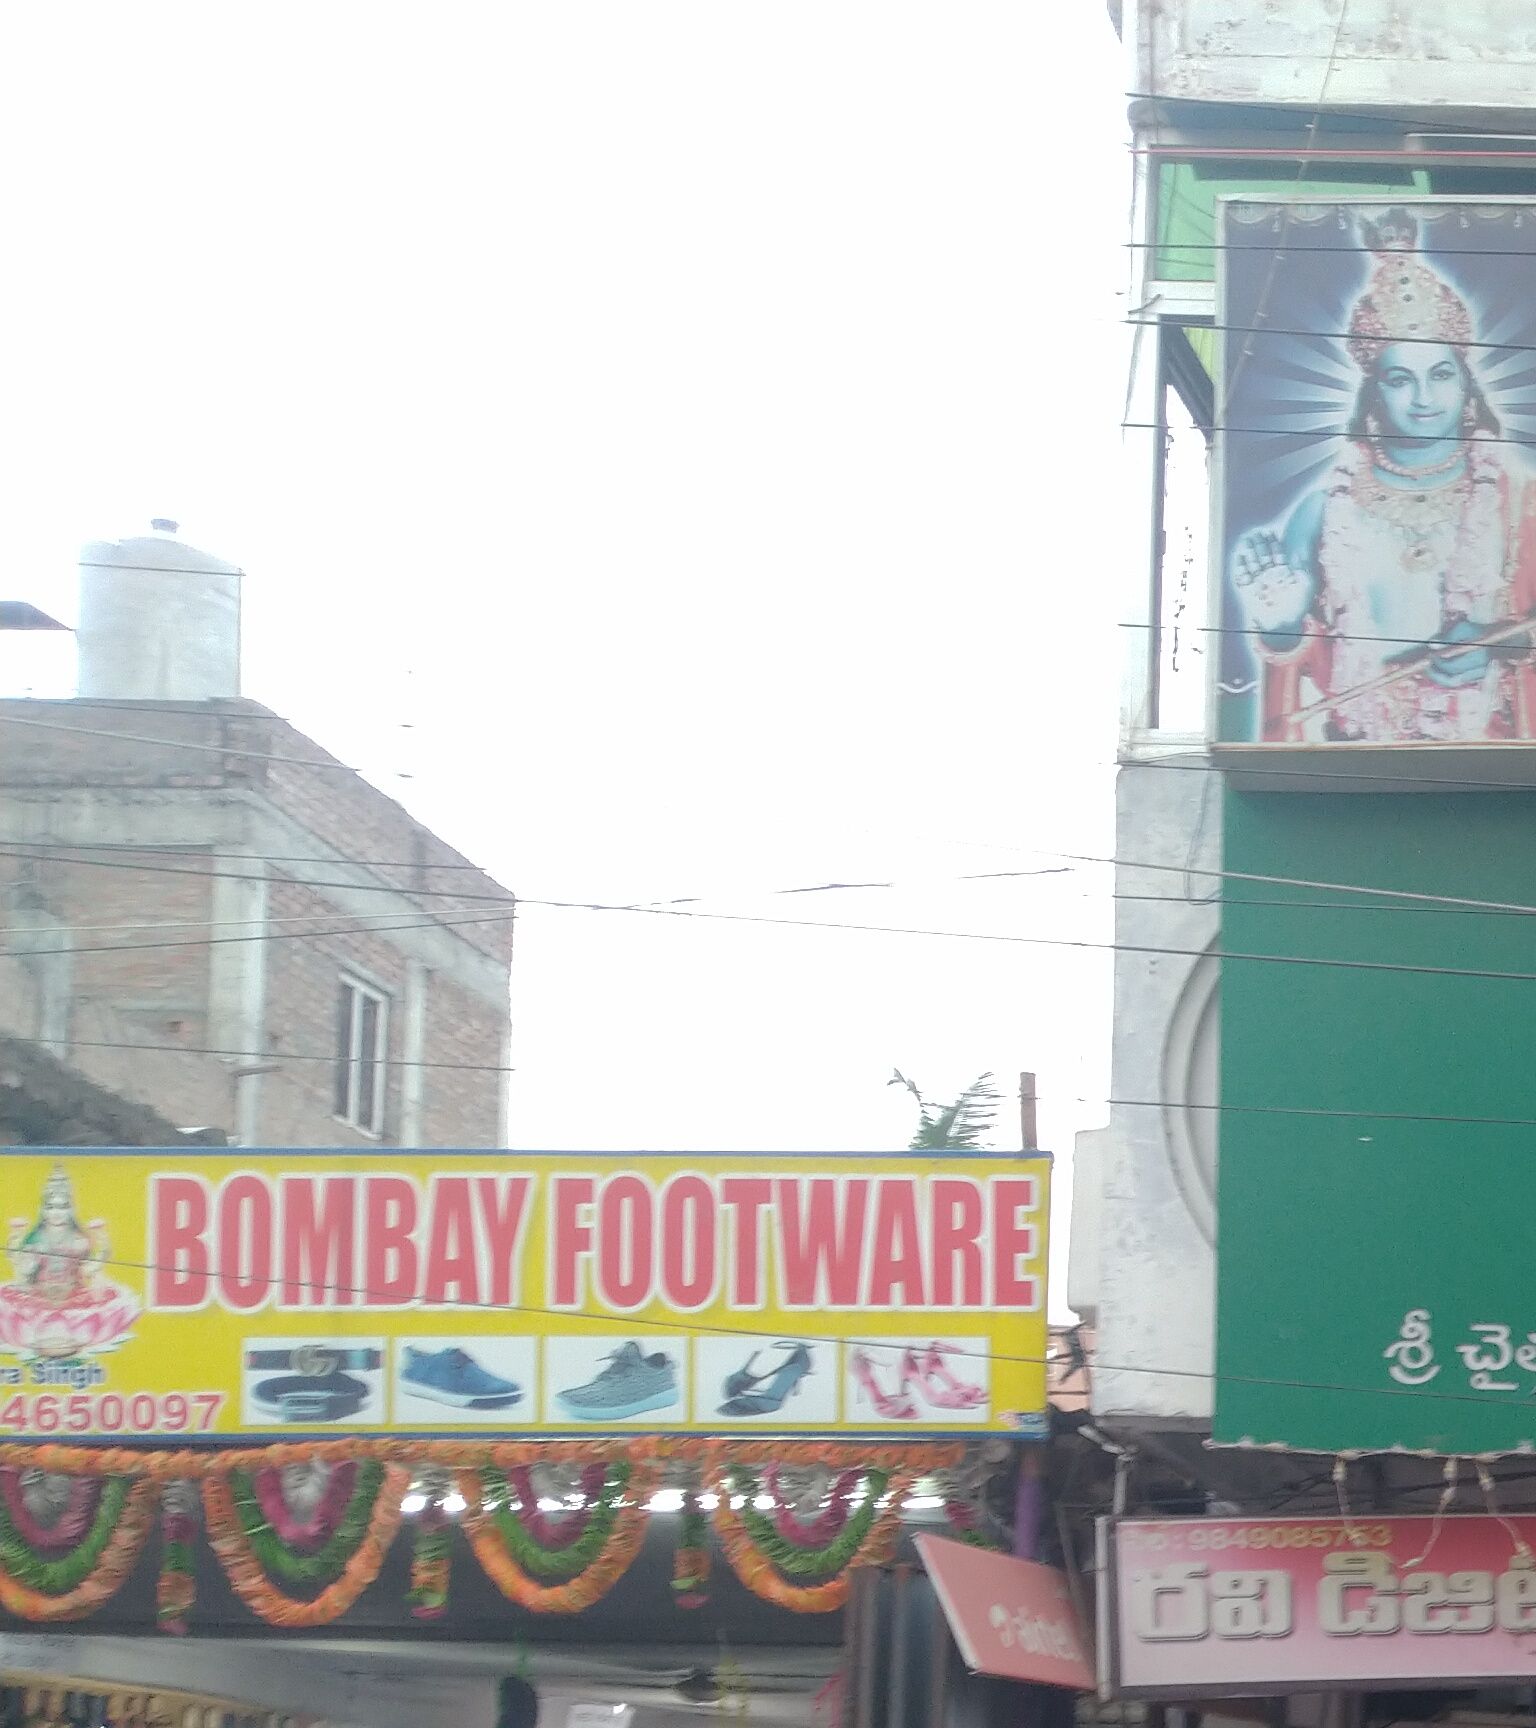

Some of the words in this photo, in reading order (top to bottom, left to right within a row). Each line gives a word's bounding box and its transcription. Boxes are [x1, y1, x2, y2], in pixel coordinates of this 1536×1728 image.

[150, 1173, 529, 1311] BOMBAY
[550, 1173, 1039, 1311] FOOTWARE
[1384, 1309, 1442, 1386] శ్రీ
